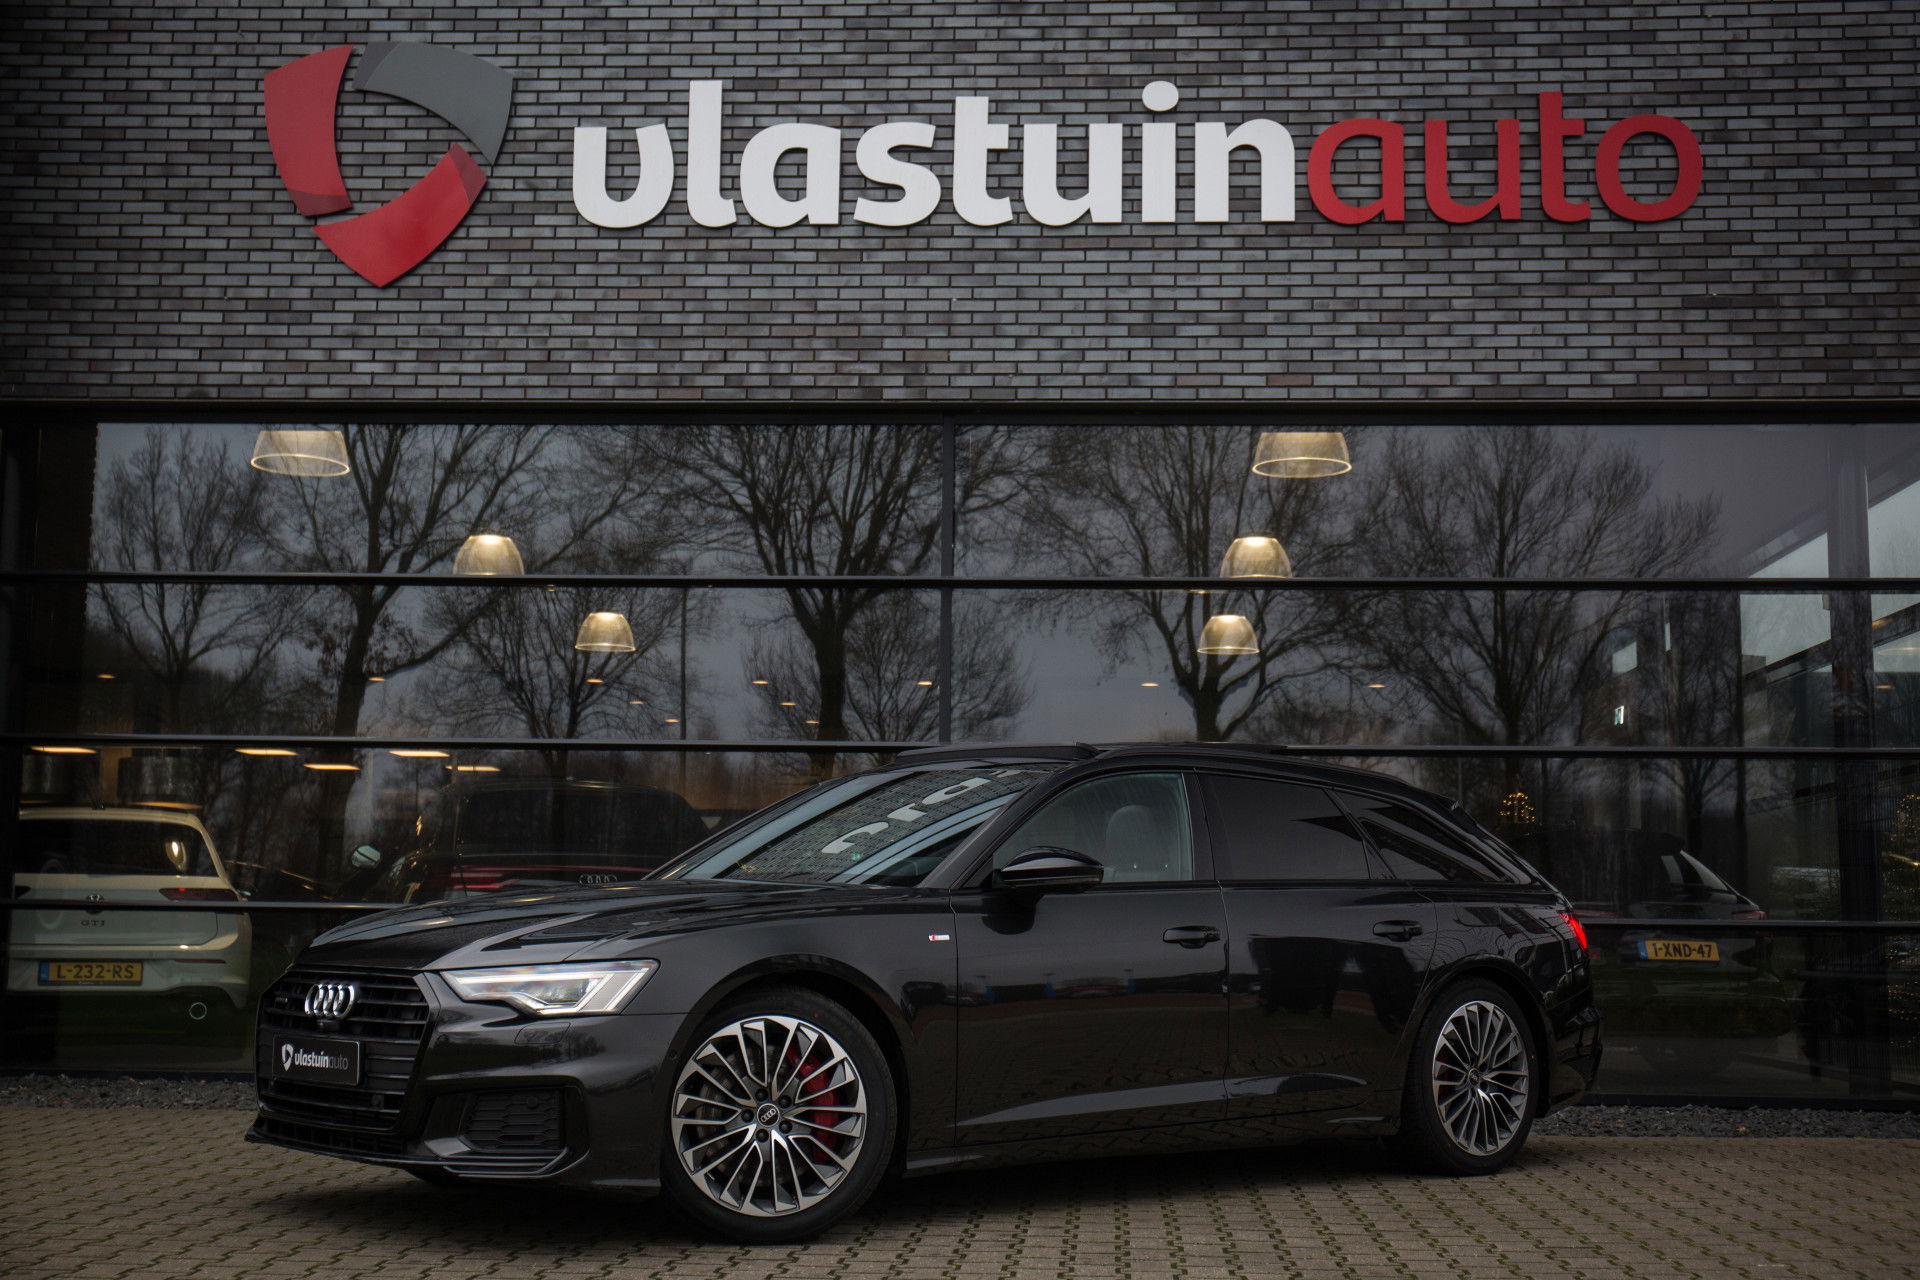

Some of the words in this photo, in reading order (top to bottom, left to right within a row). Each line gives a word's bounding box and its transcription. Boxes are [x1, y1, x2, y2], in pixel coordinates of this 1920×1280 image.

[572, 80, 1703, 228] vlastuinauto
[1652, 943, 1712, 958] 1-XND-47
[56, 964, 135, 979] L-232-RS
